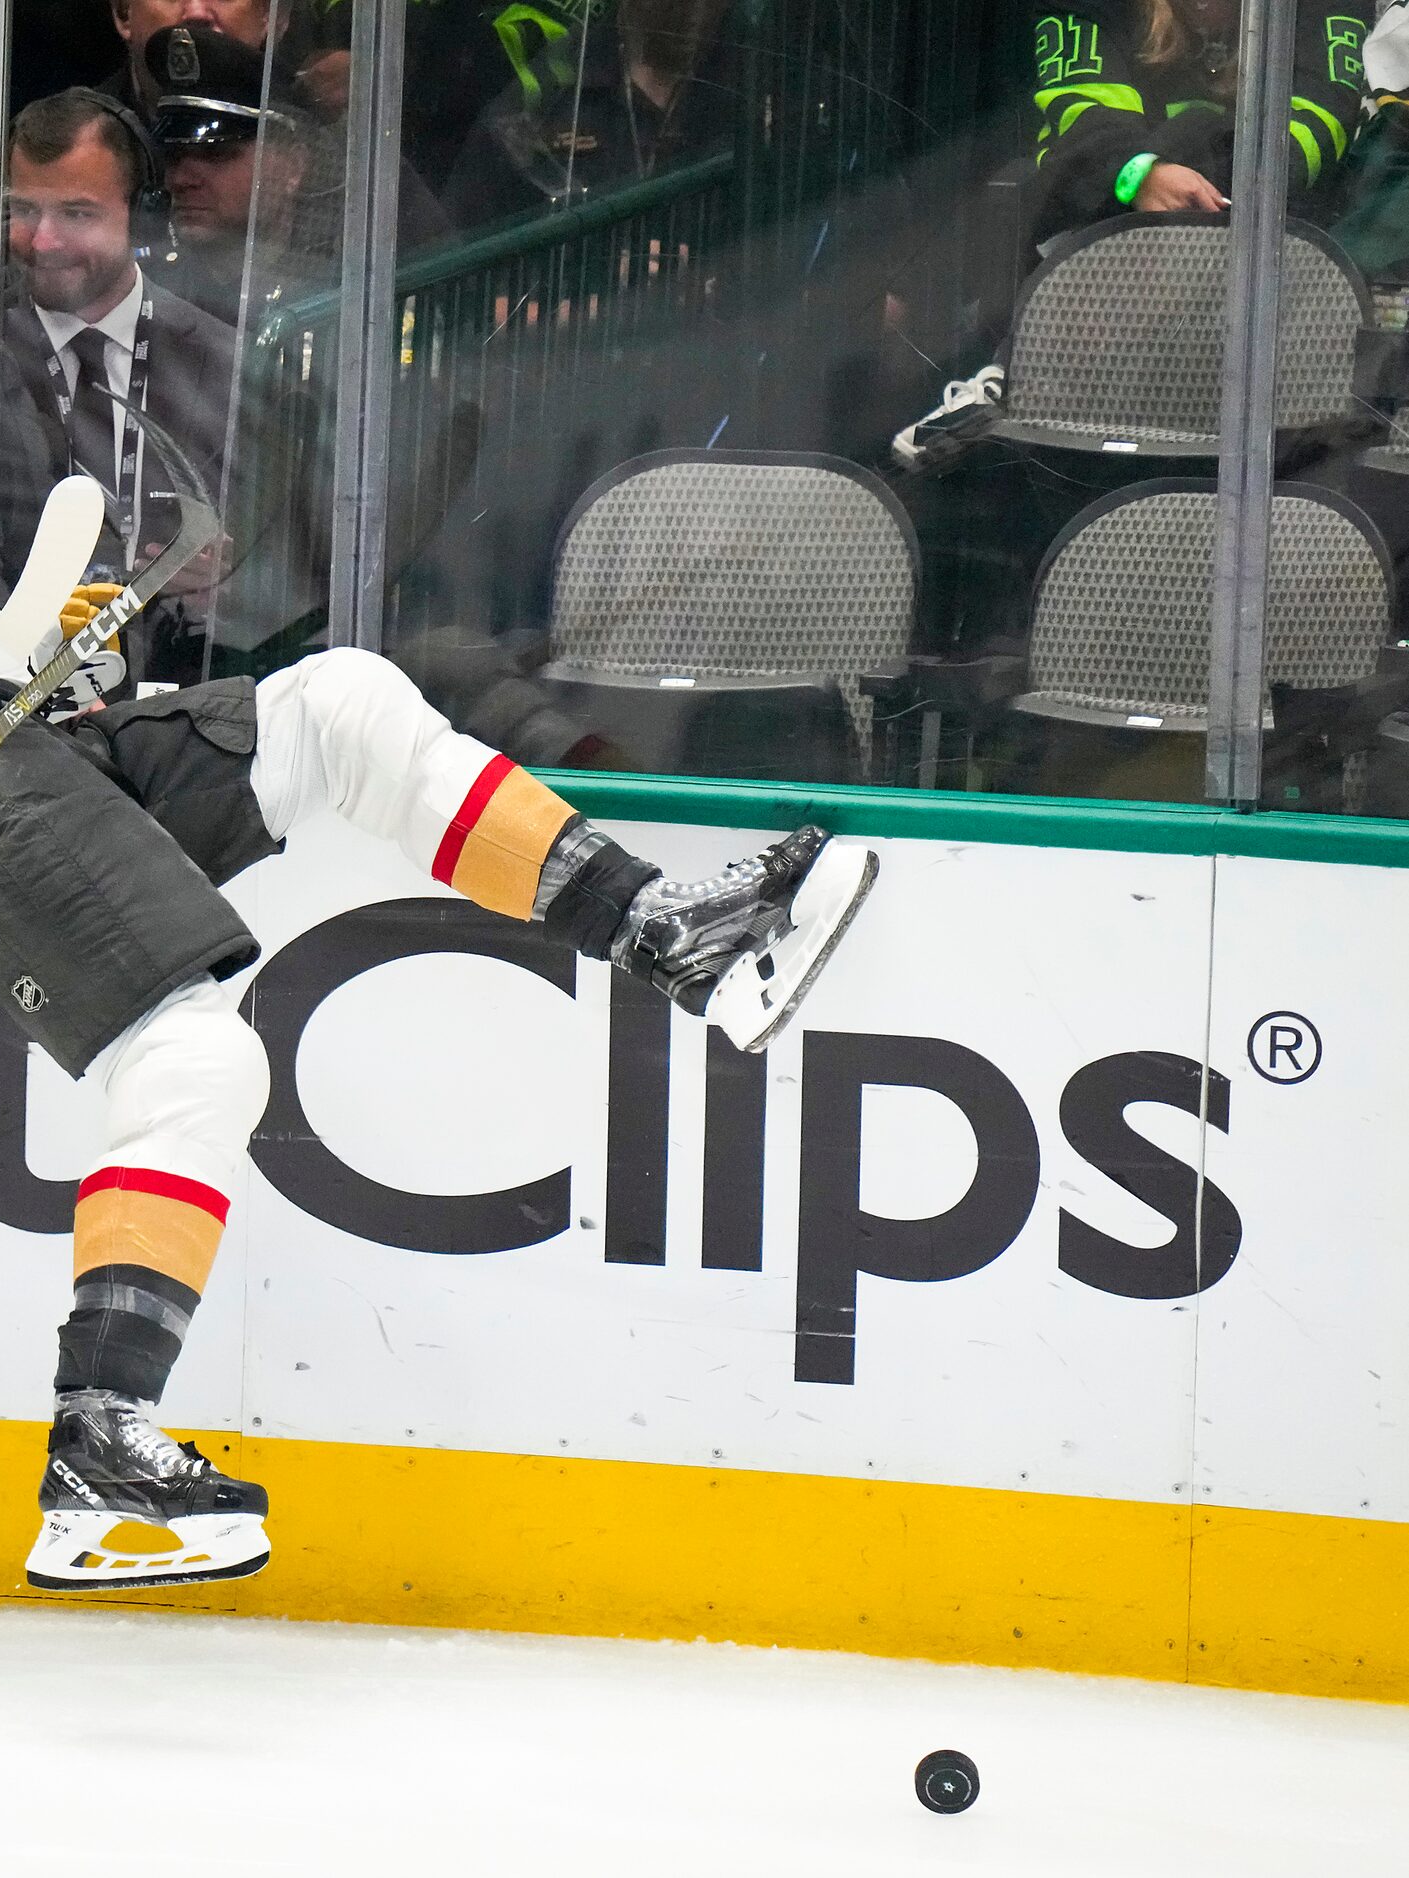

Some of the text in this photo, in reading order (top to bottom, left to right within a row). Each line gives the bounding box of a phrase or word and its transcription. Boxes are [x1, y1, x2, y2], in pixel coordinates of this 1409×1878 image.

[70, 584, 144, 661] CCM
[247, 897, 1243, 1386] Clips
[52, 1458, 103, 1506] CCM
